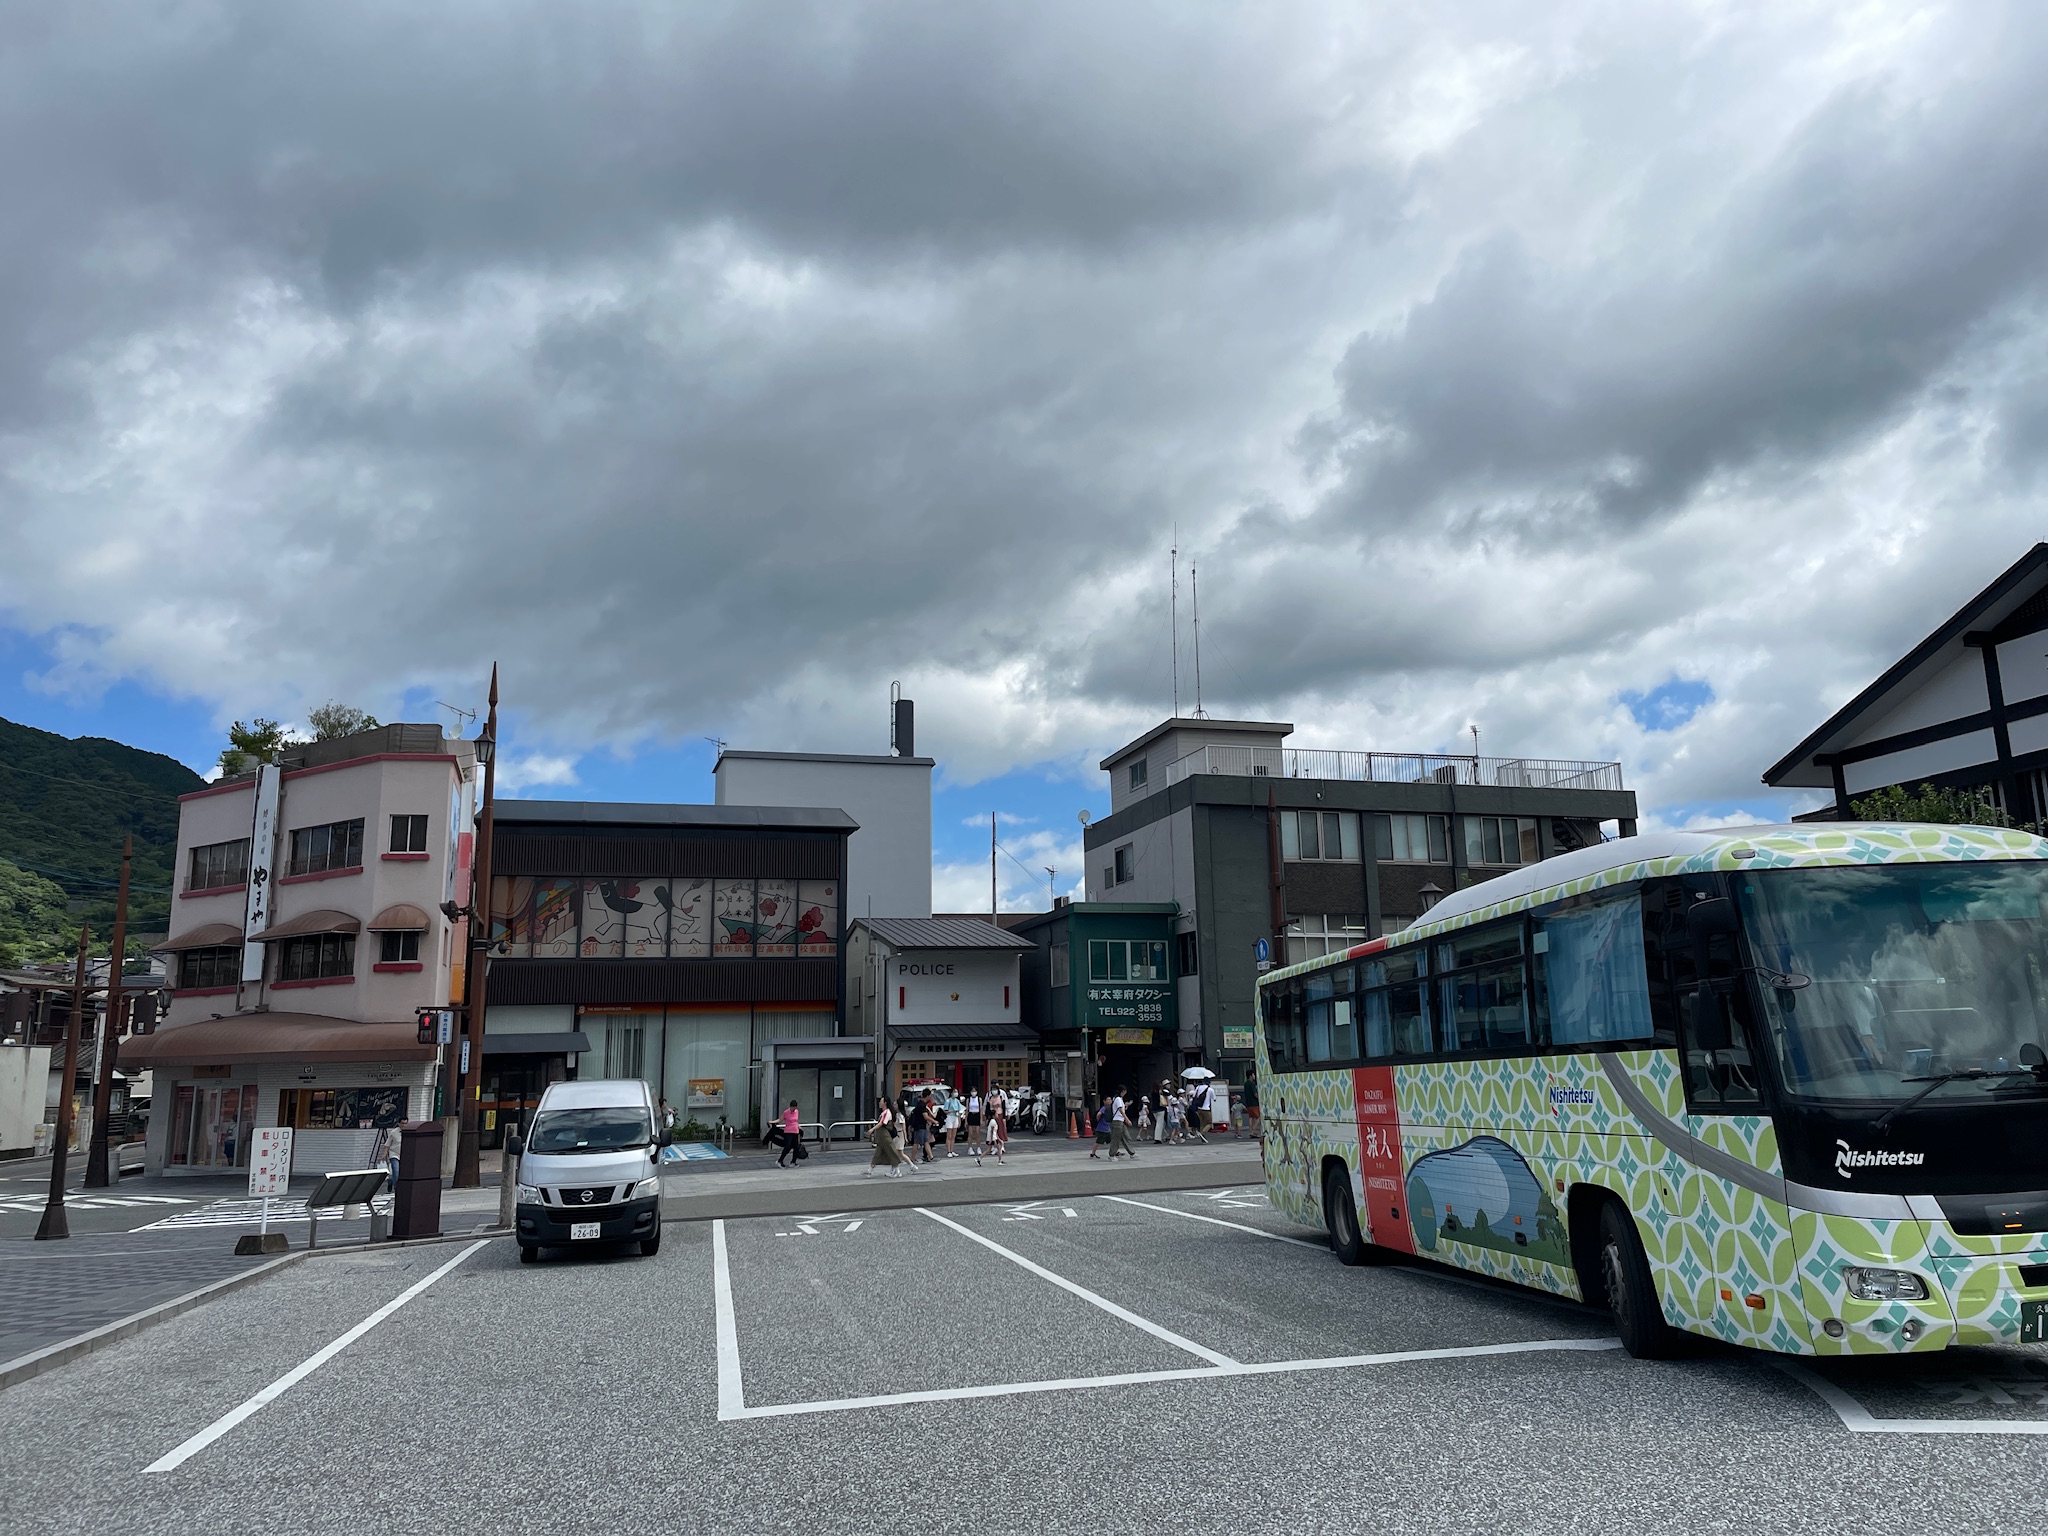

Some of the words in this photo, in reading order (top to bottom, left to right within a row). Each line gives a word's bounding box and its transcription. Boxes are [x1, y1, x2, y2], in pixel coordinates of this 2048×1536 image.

[899, 964, 954, 975] POLICE
[1137, 1004, 1162, 1012] 3838
[1137, 1013, 1162, 1021] 3553
[258, 1131, 270, 1193] 駐車禁止
[268, 1131, 280, 1193] Uターン禁止
[278, 1131, 290, 1183] ロータリー内
[1834, 1150, 1925, 1168] Nishitetsu
[577, 1228, 599, 1238] 26-09
